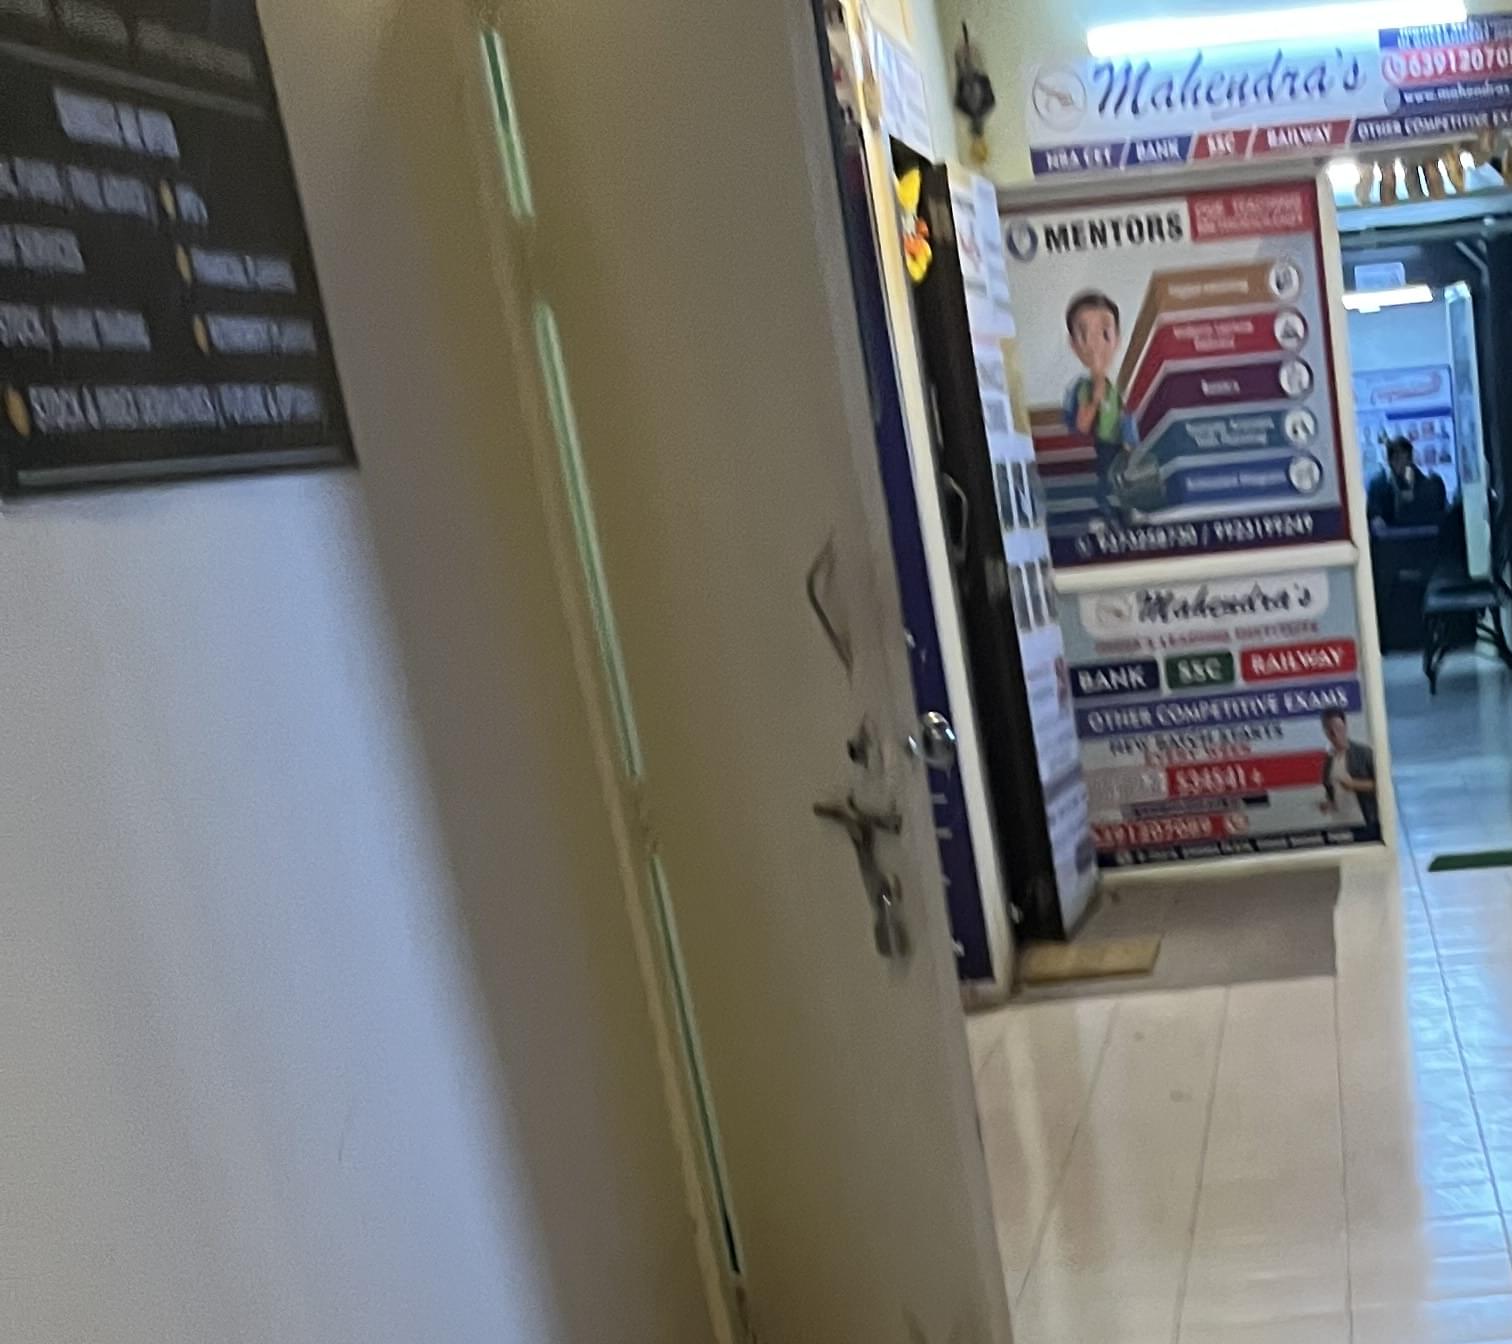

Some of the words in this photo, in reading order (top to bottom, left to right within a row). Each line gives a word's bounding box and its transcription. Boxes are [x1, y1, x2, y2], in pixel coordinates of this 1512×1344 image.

[1092, 48, 1366, 116] Mahendra's
[1135, 137, 1181, 163] BANK
[1206, 132, 1235, 159] SSC
[1266, 123, 1331, 148] RAILWAY
[1357, 118, 1401, 141] OTHER
[1403, 112, 1488, 136] COMPETITIVE
[1044, 211, 1184, 254] MENTORS
[1136, 581, 1312, 624] Mahendra's
[1079, 666, 1147, 693] BANK
[1178, 657, 1221, 683] SSC
[1251, 647, 1343, 675] RAILWAY
[1087, 708, 1152, 733] OTHER
[1156, 696, 1279, 724] COMPETITIVE
[1284, 686, 1349, 710] EXAMS
